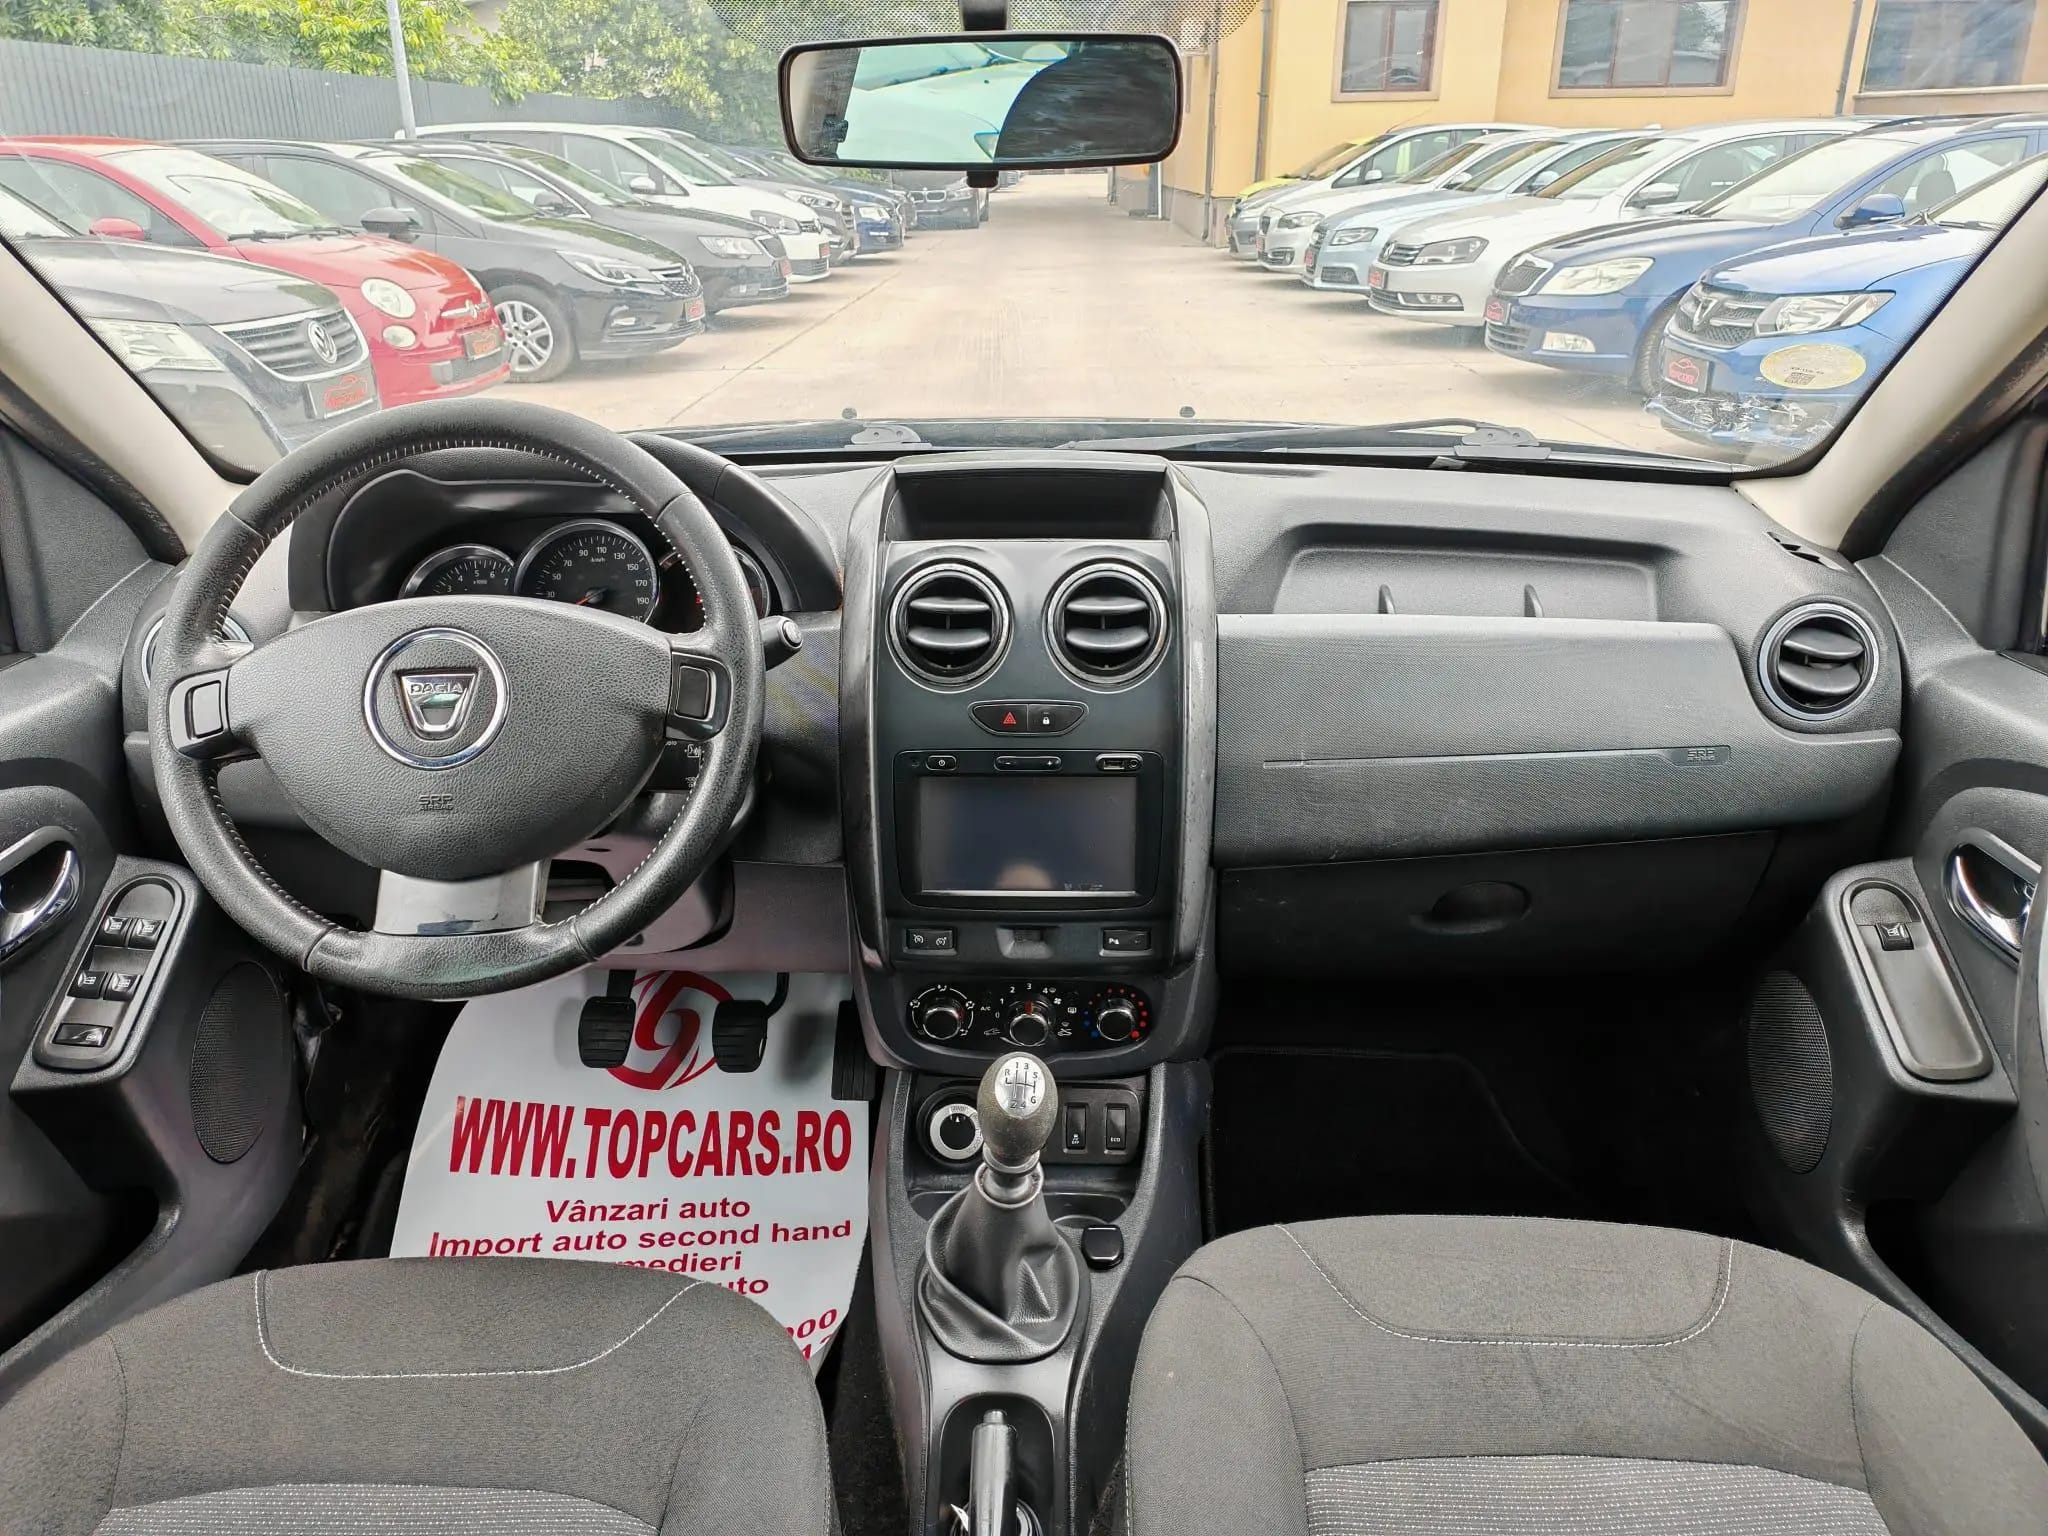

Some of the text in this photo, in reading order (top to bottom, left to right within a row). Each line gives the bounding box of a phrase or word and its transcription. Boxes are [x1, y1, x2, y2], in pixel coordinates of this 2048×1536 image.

[578, 549, 589, 557] 90
[596, 546, 608, 554] 110
[613, 552, 626, 560] 130
[563, 559, 573, 567] 70
[626, 563, 640, 571] 150
[551, 573, 562, 581] 50
[635, 579, 648, 587] 170
[637, 597, 650, 606] 190
[410, 682, 464, 695] DACIA
[1009, 986, 1016, 994] 2
[449, 1095, 853, 1180] WWW.TOPCARS.RO
[546, 1197, 751, 1224] Vânzari auto
[428, 1220, 852, 1259] Import auto second hand
